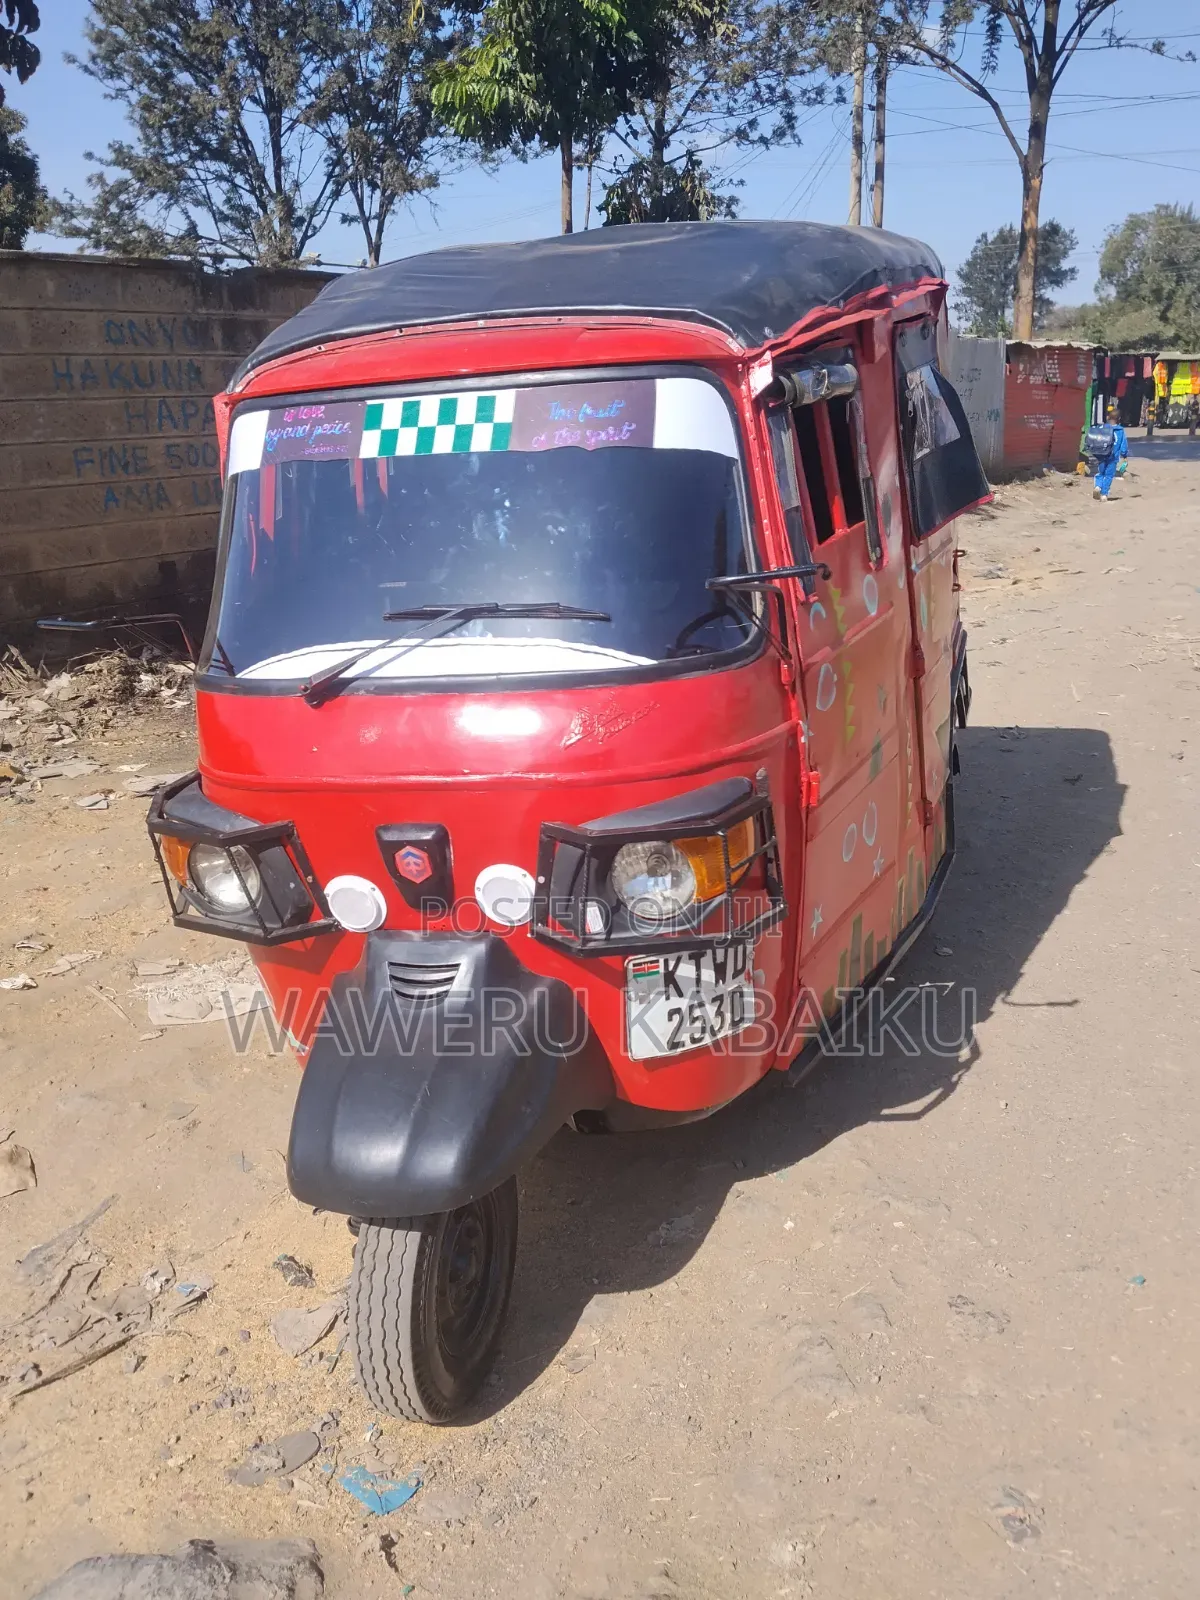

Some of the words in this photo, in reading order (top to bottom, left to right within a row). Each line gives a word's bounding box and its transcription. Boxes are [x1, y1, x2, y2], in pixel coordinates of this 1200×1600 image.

[52, 357, 204, 390] HAKUNA
[124, 396, 215, 432] HAPA
[72, 444, 154, 478] FINE
[666, 989, 745, 1051] 253D
